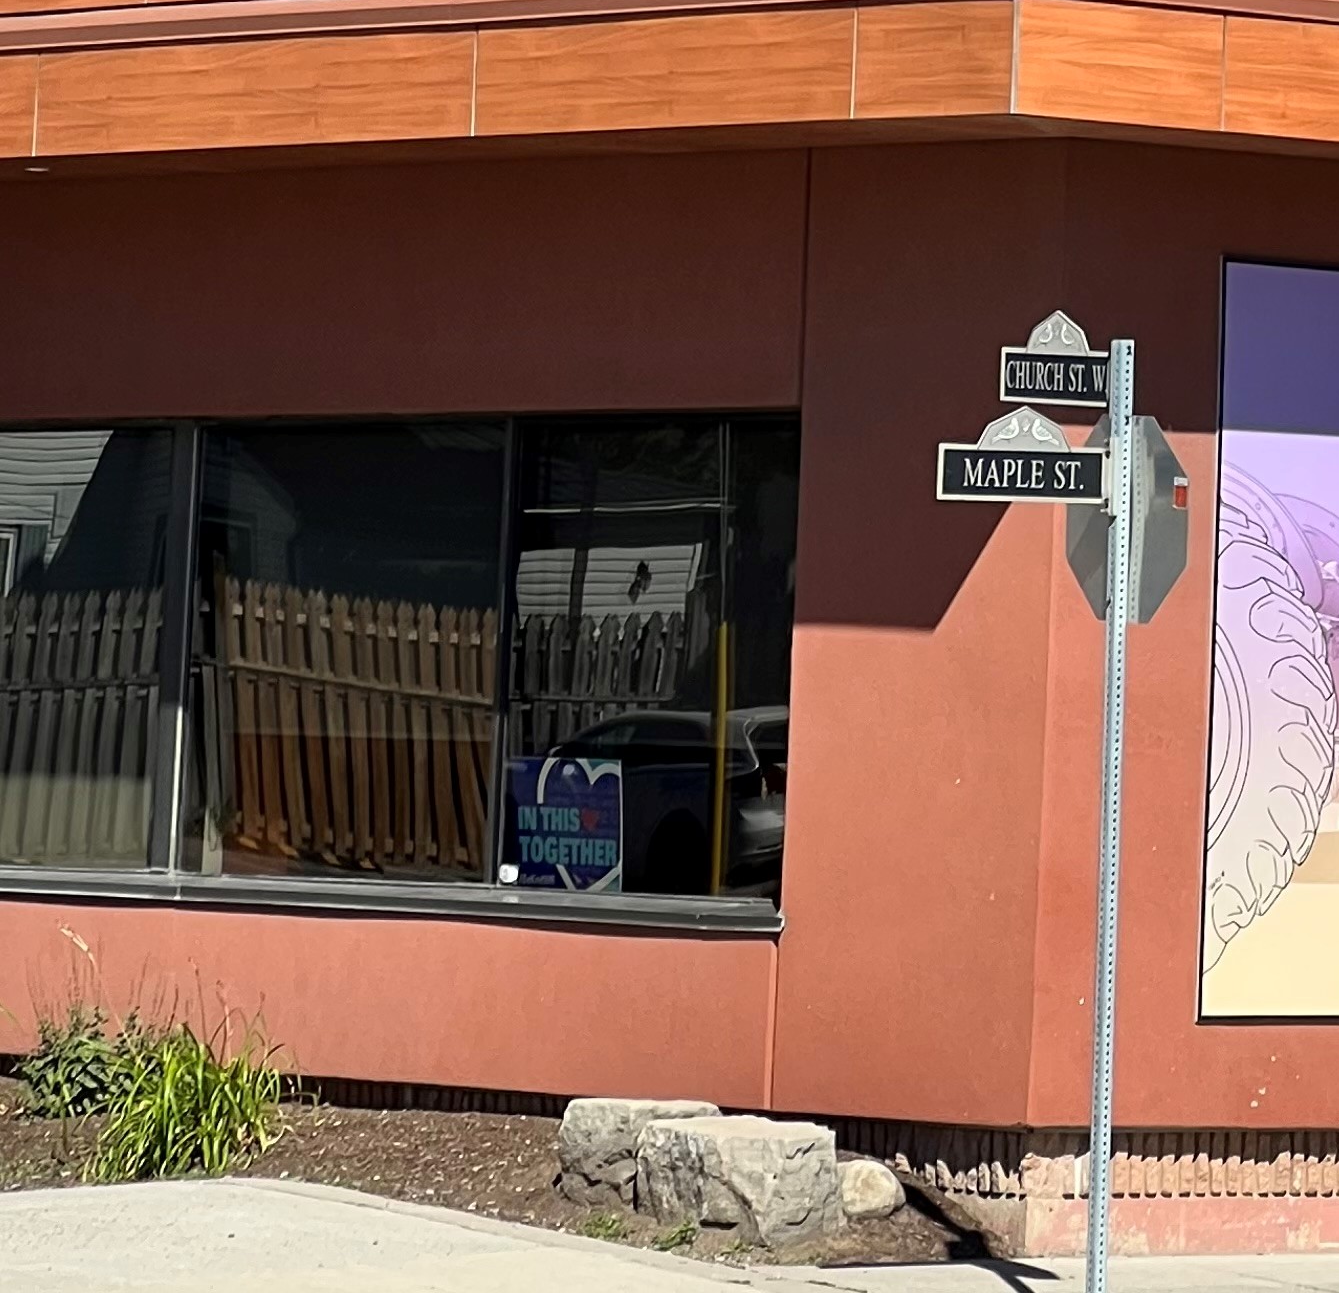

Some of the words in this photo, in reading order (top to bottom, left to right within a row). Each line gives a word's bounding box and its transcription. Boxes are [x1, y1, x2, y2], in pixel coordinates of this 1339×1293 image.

[1006, 360, 1064, 392] CHURCH
[1068, 363, 1088, 393] ST.
[963, 458, 1045, 489] MAPLE
[1053, 460, 1084, 491] ST.
[518, 805, 537, 830] IN
[540, 806, 580, 832] THIS
[518, 835, 617, 867] TOGETHER
